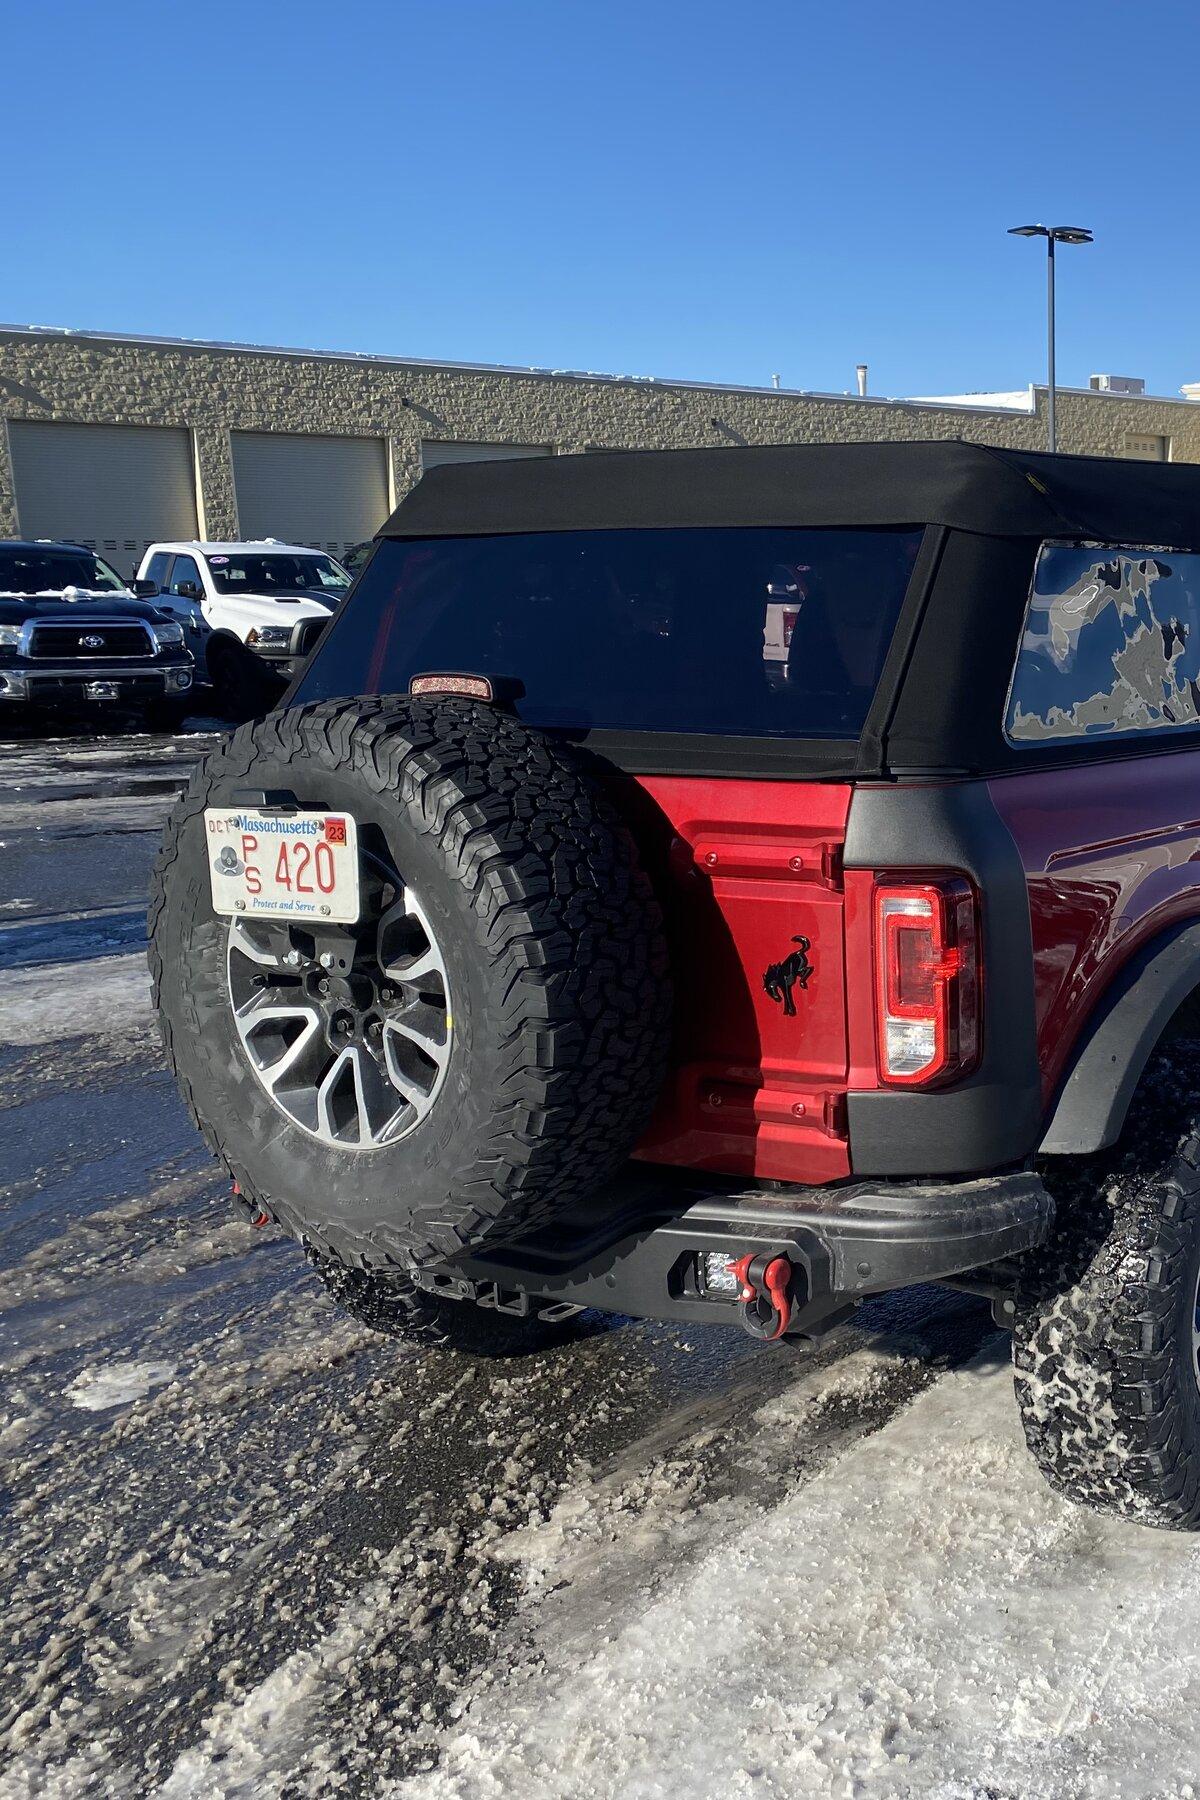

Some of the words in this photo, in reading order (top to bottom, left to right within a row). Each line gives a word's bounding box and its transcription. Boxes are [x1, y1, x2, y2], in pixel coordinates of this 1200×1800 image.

[209, 820, 230, 834] OCT
[238, 815, 317, 835] Massachusetts
[329, 827, 344, 840] 23
[275, 841, 336, 894] 420
[252, 897, 278, 909] Protect
[279, 900, 294, 910] and
[295, 901, 316, 912] Serve
